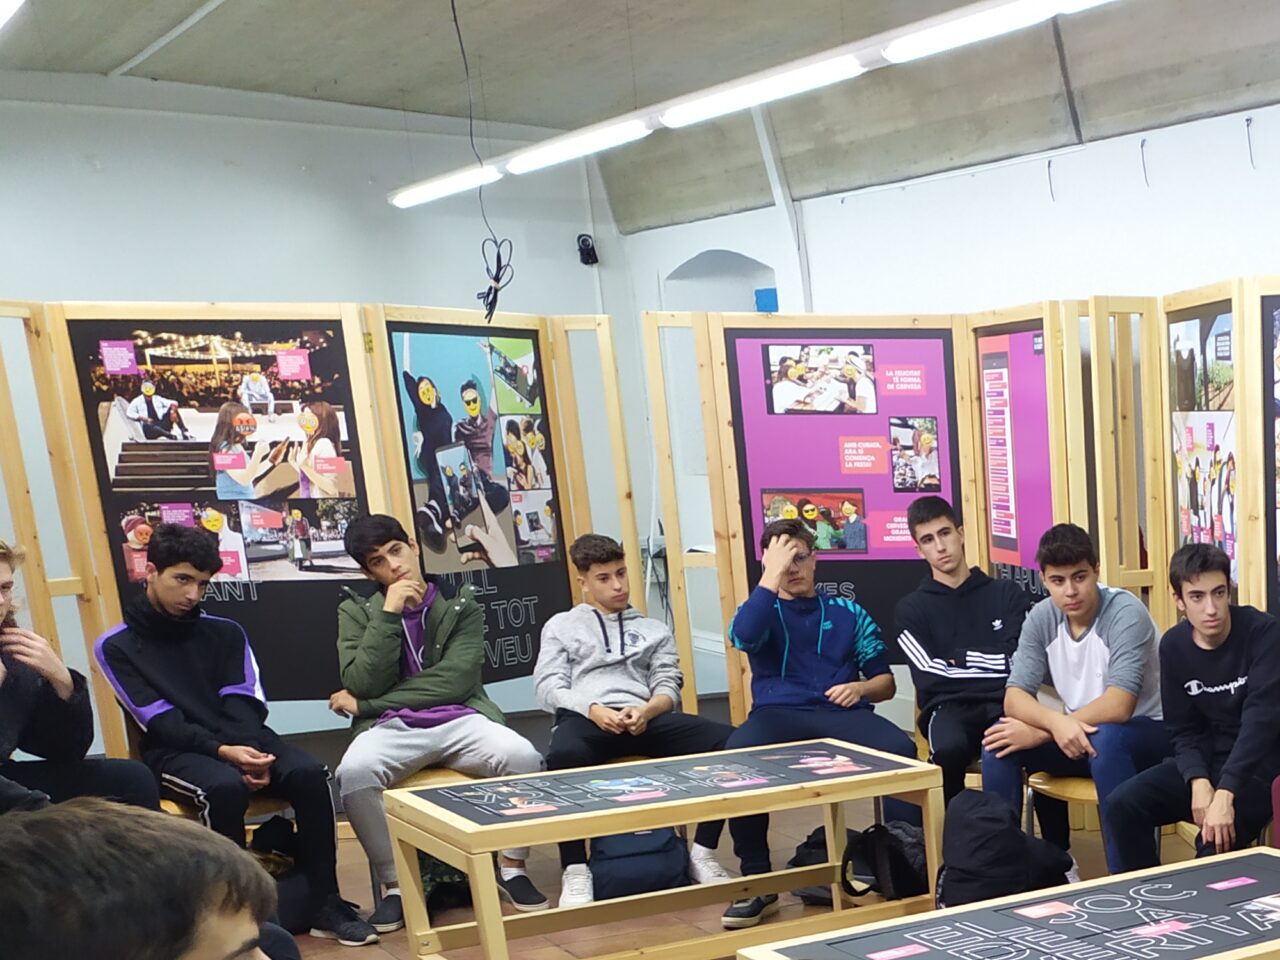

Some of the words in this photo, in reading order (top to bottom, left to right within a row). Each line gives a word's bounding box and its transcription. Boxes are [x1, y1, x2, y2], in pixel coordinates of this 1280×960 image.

[200, 580, 262, 602] ANT
[491, 596, 539, 629] TOT
[484, 633, 533, 668] VEU
[1184, 676, 1248, 695] Champio
